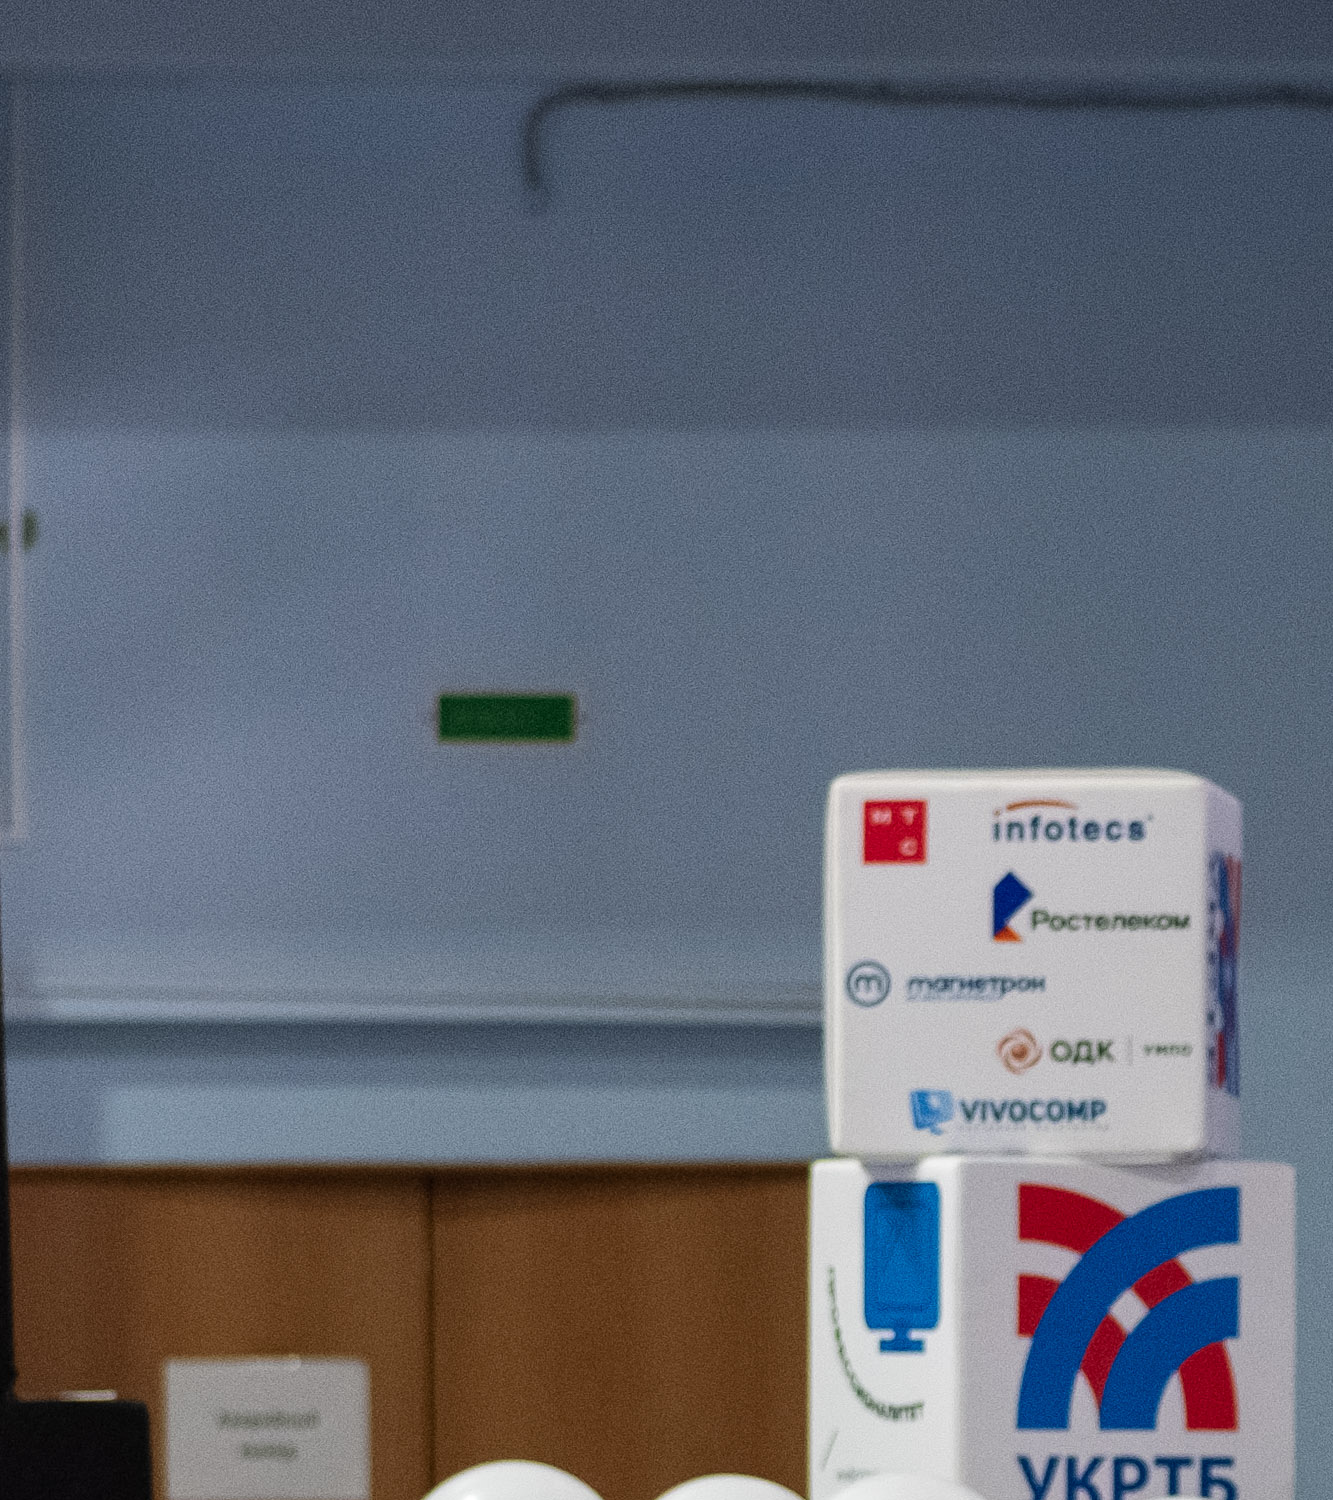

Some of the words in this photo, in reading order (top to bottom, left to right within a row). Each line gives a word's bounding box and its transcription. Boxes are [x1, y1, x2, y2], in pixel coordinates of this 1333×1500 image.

[993, 810, 1146, 841] infotecs
[1031, 909, 1191, 932] Ростелеком
[1050, 1039, 1115, 1065] ОДК
[961, 1099, 1107, 1123] VIVOCOMP
